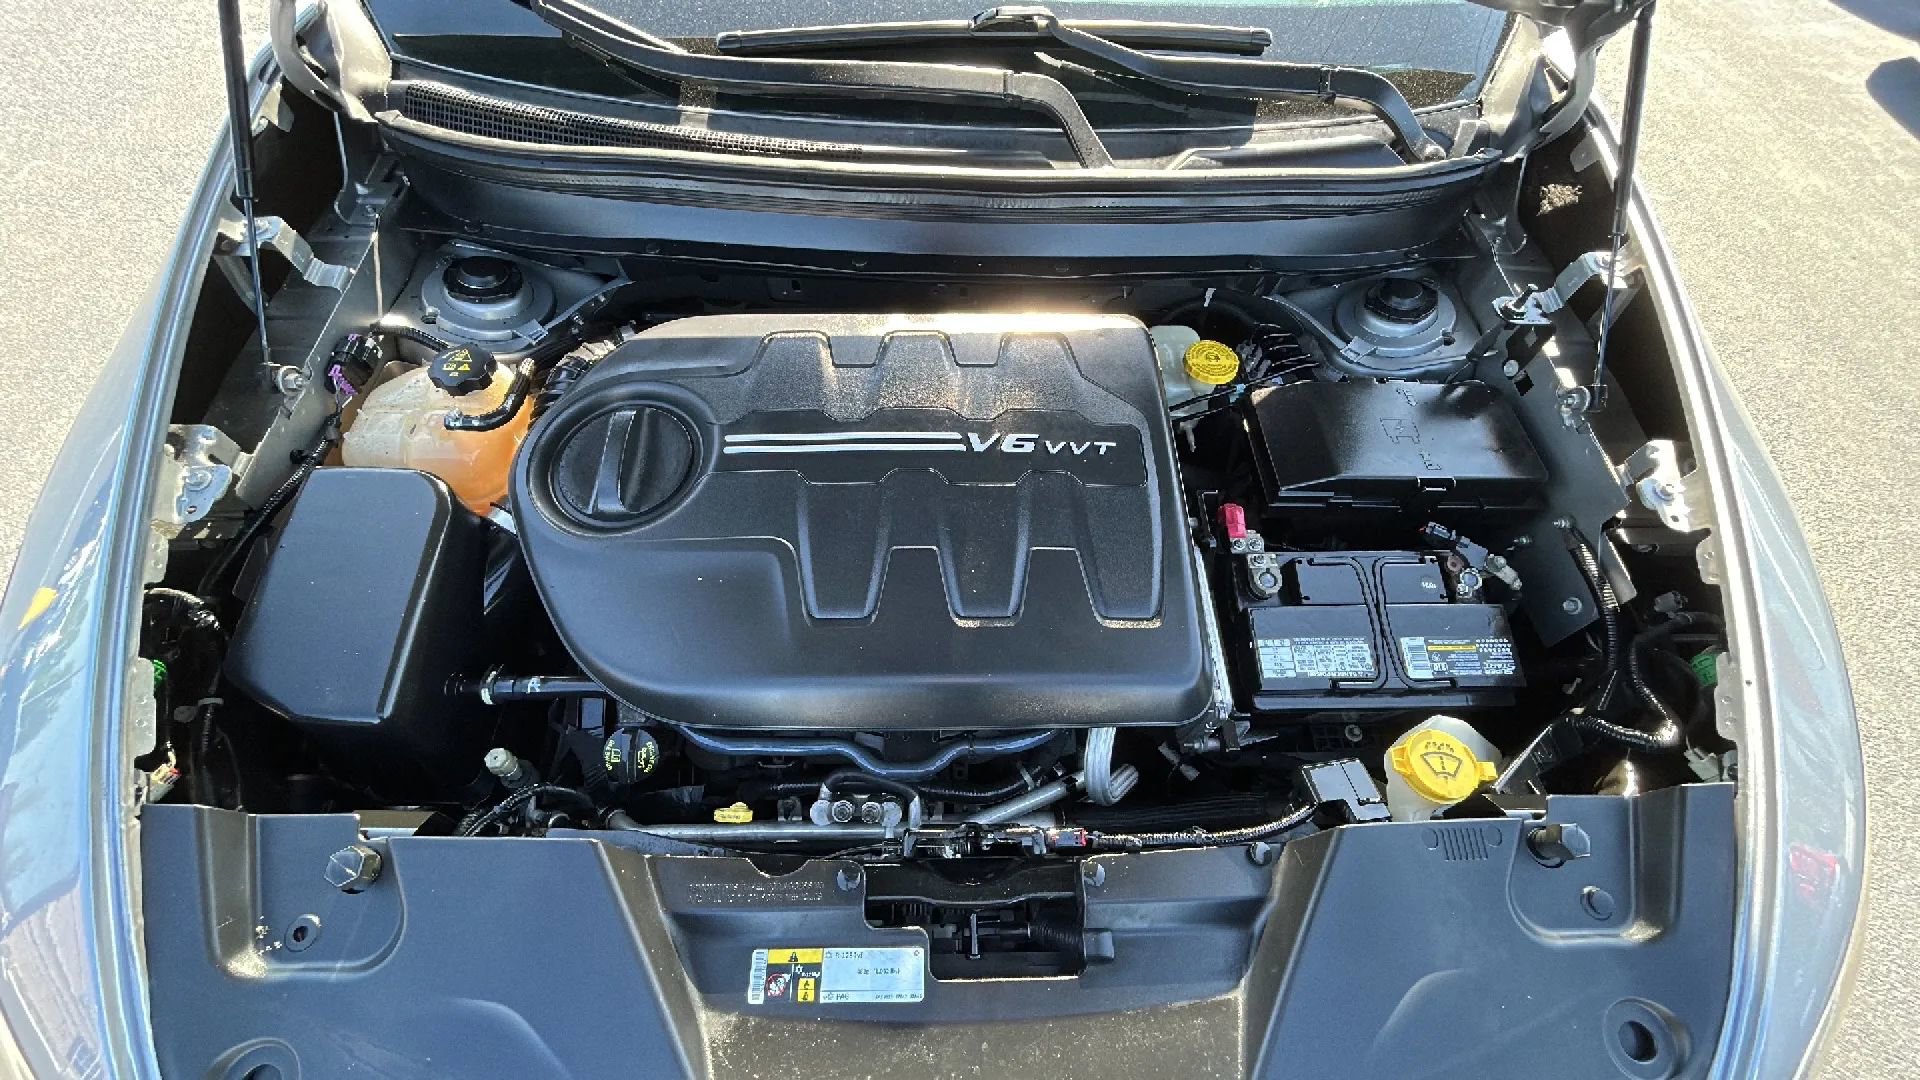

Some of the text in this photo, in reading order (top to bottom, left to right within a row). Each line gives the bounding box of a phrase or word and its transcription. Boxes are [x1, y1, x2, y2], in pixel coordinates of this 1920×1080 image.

[967, 432, 1117, 455] V6 VVT
[1483, 662, 1516, 670] START
